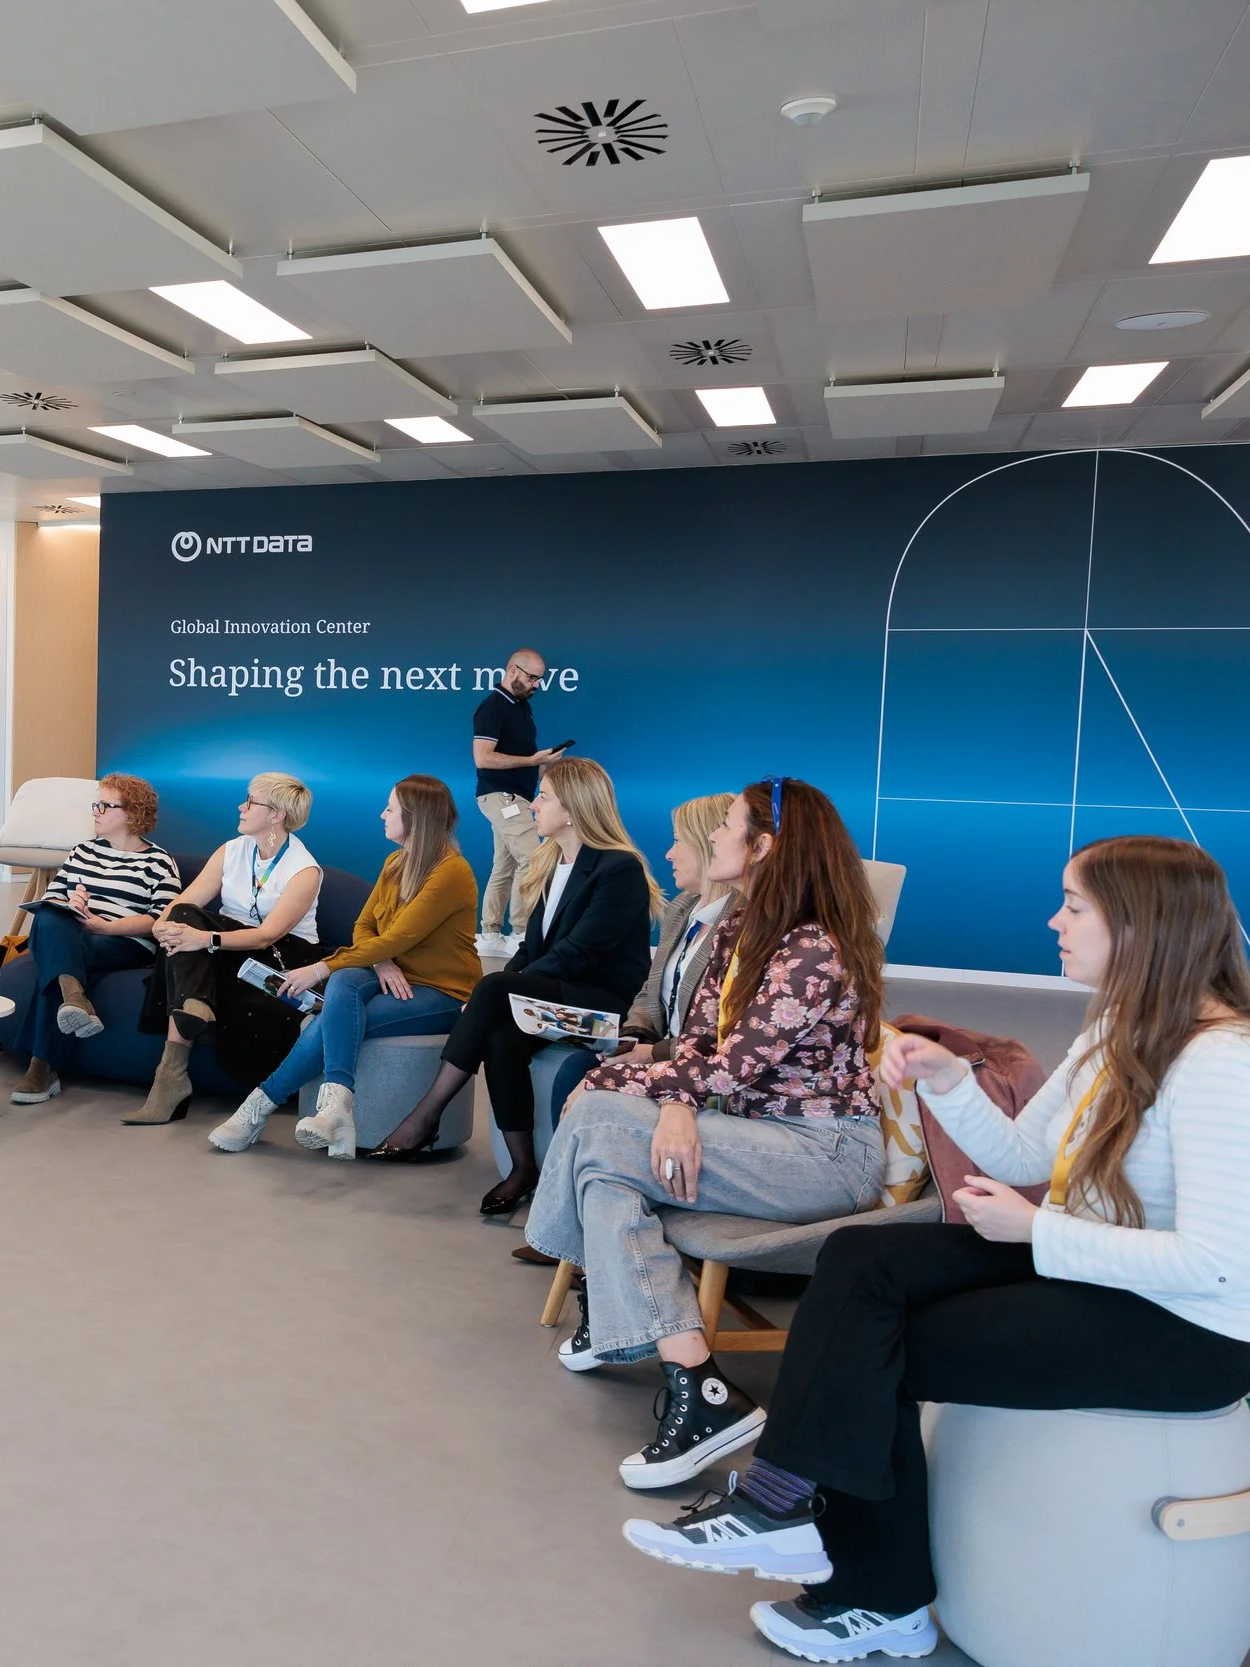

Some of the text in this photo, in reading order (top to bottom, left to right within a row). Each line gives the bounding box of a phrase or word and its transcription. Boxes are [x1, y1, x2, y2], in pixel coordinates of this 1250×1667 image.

[206, 537, 251, 555] NTT
[170, 619, 371, 634] Global Innovation Center
[169, 657, 579, 698] Shaping the next mve
